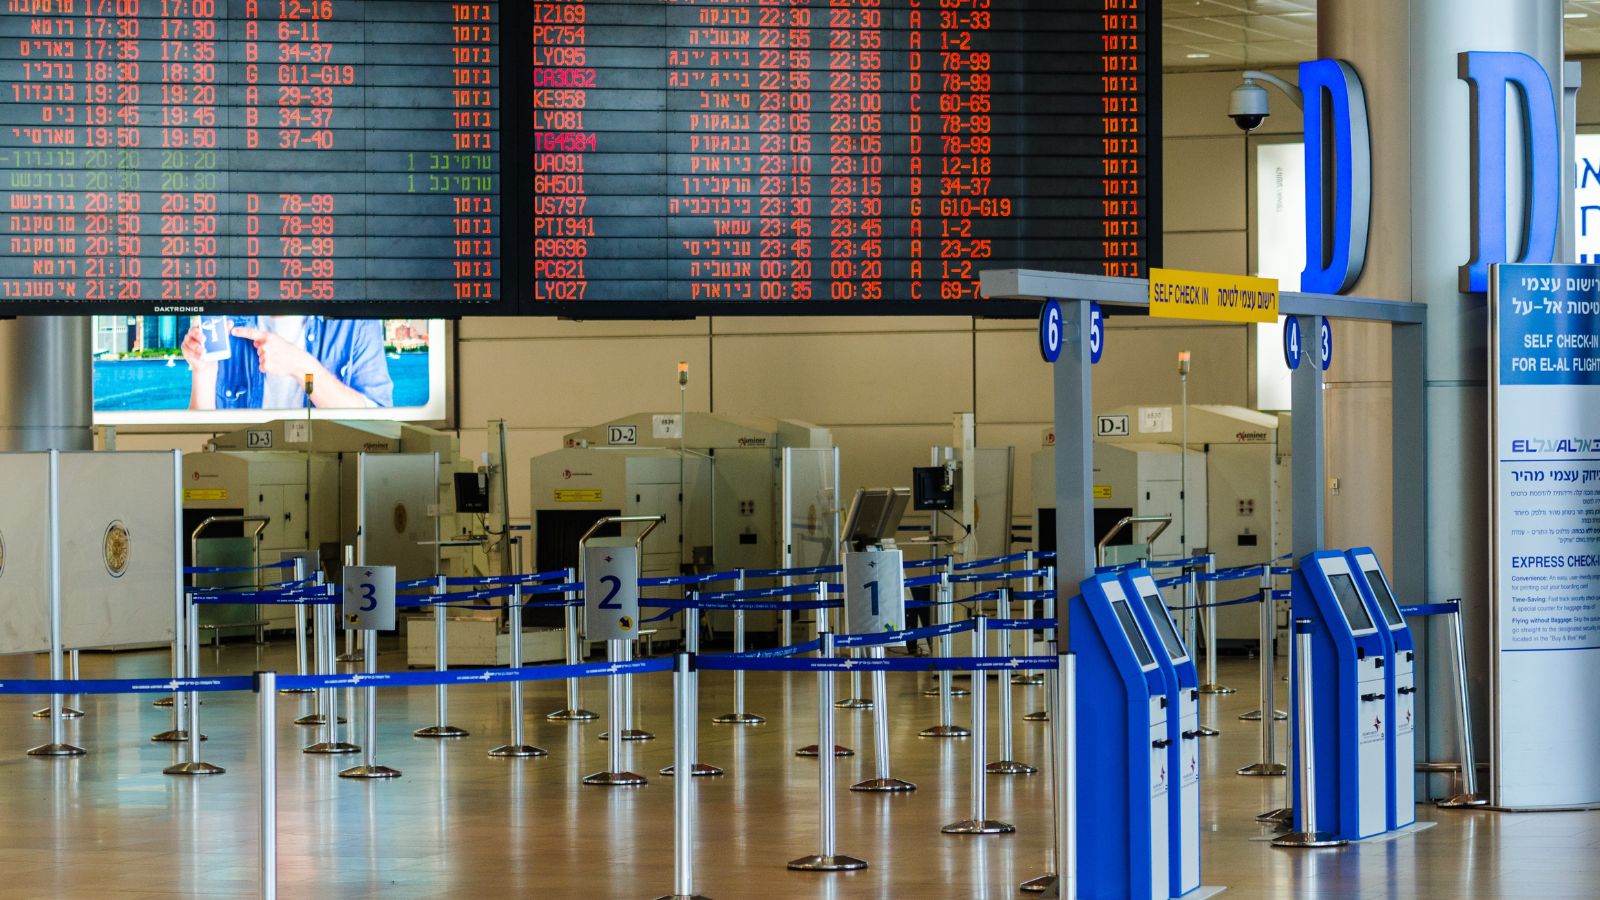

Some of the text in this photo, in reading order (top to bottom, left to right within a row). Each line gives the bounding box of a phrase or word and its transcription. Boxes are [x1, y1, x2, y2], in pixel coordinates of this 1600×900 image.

[533, 3, 586, 23] IZ169
[758, 7, 811, 27] 22:30
[829, 8, 881, 28] 22:30
[909, 9, 921, 28] A
[939, 10, 991, 29] 31-33
[1101, 14, 1137, 30] בזמן
[85, 17, 140, 38] 17:30
[161, 18, 216, 39] 17:30
[245, 20, 259, 39] A
[277, 20, 320, 41] 6-11
[452, 25, 491, 42] בזמן
[533, 25, 586, 44] PC754
[758, 28, 811, 48] 22:55
[829, 29, 882, 49] 22:55
[909, 30, 922, 49] A
[941, 31, 971, 50] 1-2
[1101, 35, 1138, 51] בזמן
[85, 61, 139, 82] 18:30
[162, 62, 215, 82] 18:30
[245, 63, 258, 83] G
[278, 64, 355, 84] G11-G19
[452, 68, 491, 86] בזמן
[85, 83, 140, 103] 19:20
[162, 84, 215, 104] 19:20
[246, 85, 259, 104] A
[278, 85, 333, 106] 29-33
[452, 89, 491, 106] בזמן
[533, 88, 587, 108] KE958
[759, 91, 811, 111] 23:00
[829, 92, 881, 111] 23:00
[909, 93, 921, 112] C
[939, 93, 991, 112] 60-65
[1102, 97, 1138, 113] בזמן
[533, 110, 583, 130] LY081
[759, 112, 811, 132] 23:05
[830, 113, 881, 132] 23:05
[909, 113, 922, 132] D
[939, 114, 991, 133] 78-99
[1102, 117, 1138, 133] בזמן
[86, 127, 140, 147] 19:50
[162, 127, 216, 147] 19:50
[246, 128, 259, 148] B
[279, 128, 334, 149] 37-40
[452, 133, 492, 149] בזמן
[533, 153, 585, 172] UA091
[759, 155, 812, 174] 23:10
[831, 155, 882, 174] 23:10
[910, 156, 922, 174] A
[941, 156, 992, 175] 12-18
[1102, 159, 1138, 175] בזמן
[1458, 51, 1560, 290] D
[86, 172, 140, 190] 20:30
[161, 172, 216, 190] 20:30
[408, 176, 416, 192] 1
[1299, 58, 1369, 295] D
[534, 216, 595, 236] PTI941
[759, 217, 813, 237] 23:45
[830, 217, 883, 237] 23:45
[910, 218, 922, 237] A
[941, 218, 972, 237] 1-2
[1102, 220, 1138, 237] בזמן
[534, 238, 588, 257] A9696
[759, 238, 812, 258] 23:45
[830, 238, 882, 258] 23:45
[910, 239, 922, 257] A
[940, 239, 992, 258] 23-25
[1102, 241, 1138, 257] בזמן
[1154, 282, 1209, 306] SELF CHECK IN
[1521, 277, 1561, 293] עצמי
[1217, 285, 1276, 311] רישום עצמי לטיסה
[1048, 307, 1059, 352] 6
[1090, 311, 1100, 354] 5
[1290, 323, 1298, 360] 4
[1321, 325, 1329, 362] 3
[1524, 334, 1599, 349] SELF CHECK-IN
[1512, 357, 1537, 372] FOR
[1540, 357, 1570, 372] EL-AL
[611, 427, 635, 442] D-2
[1100, 418, 1127, 434] D-1
[249, 432, 270, 446] D-3
[1511, 470, 1545, 482] מהיר
[1550, 470, 1579, 482] עצמי
[1512, 556, 1564, 568] EXPRESS
[360, 582, 377, 612] 3
[598, 575, 623, 610] 2
[863, 580, 879, 616] 1
